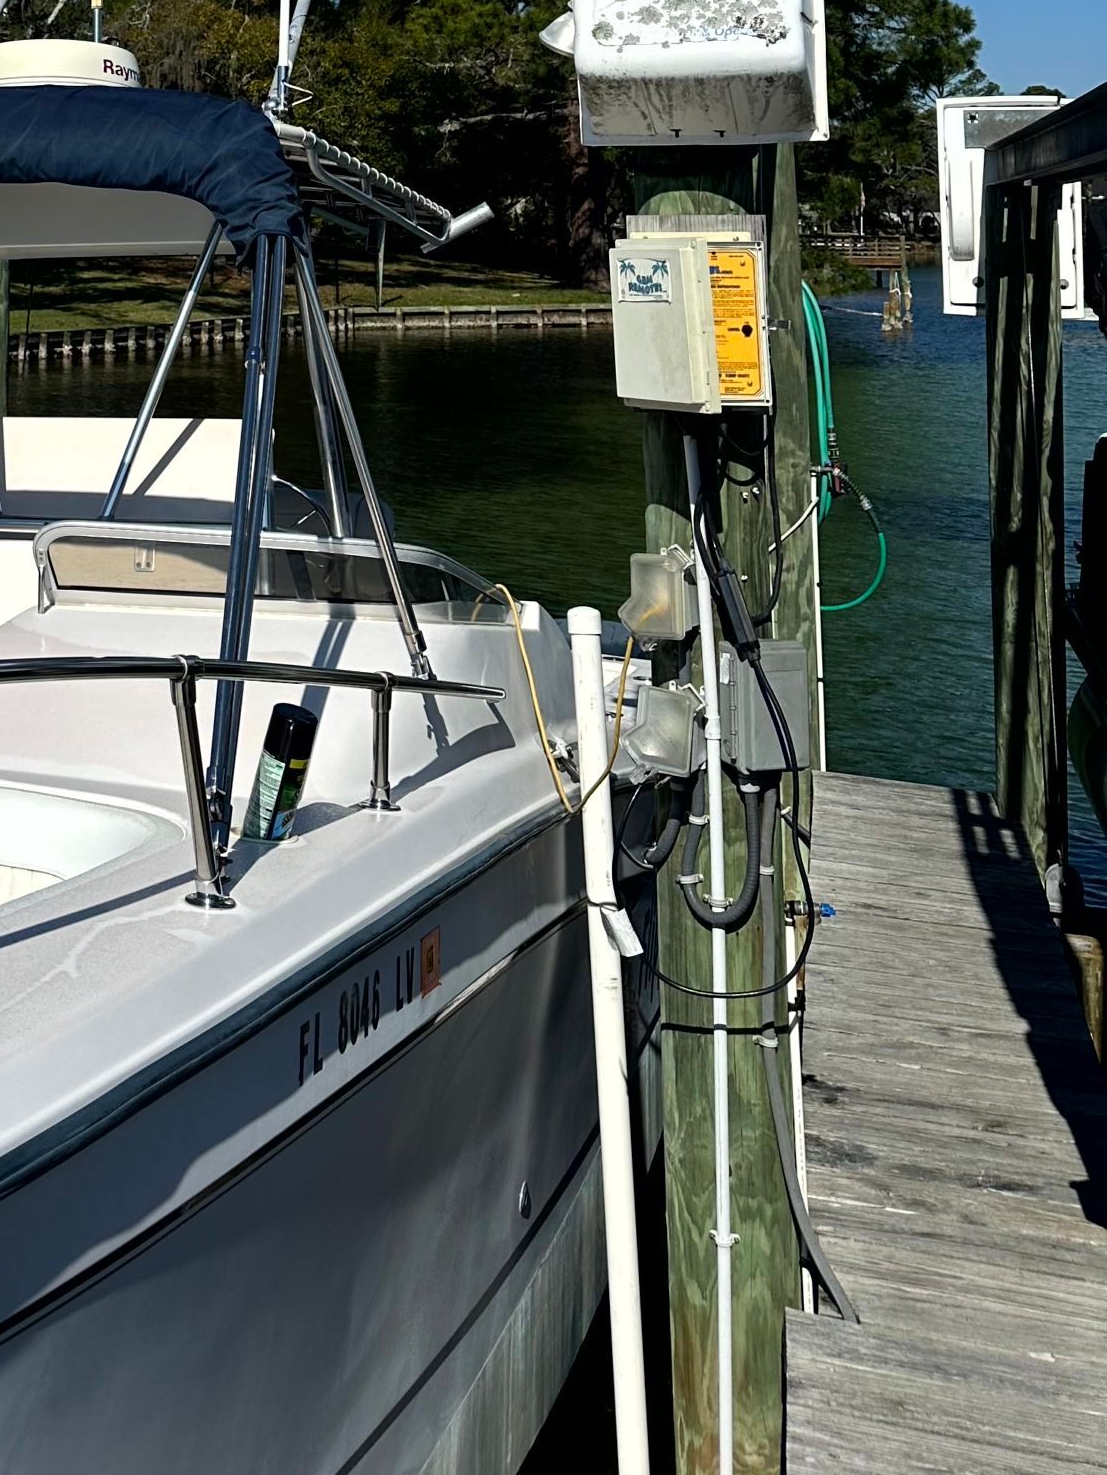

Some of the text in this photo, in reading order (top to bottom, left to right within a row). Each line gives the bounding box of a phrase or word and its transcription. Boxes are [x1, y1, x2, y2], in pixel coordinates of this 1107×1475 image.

[298, 946, 415, 1087] FL 8046 LV
